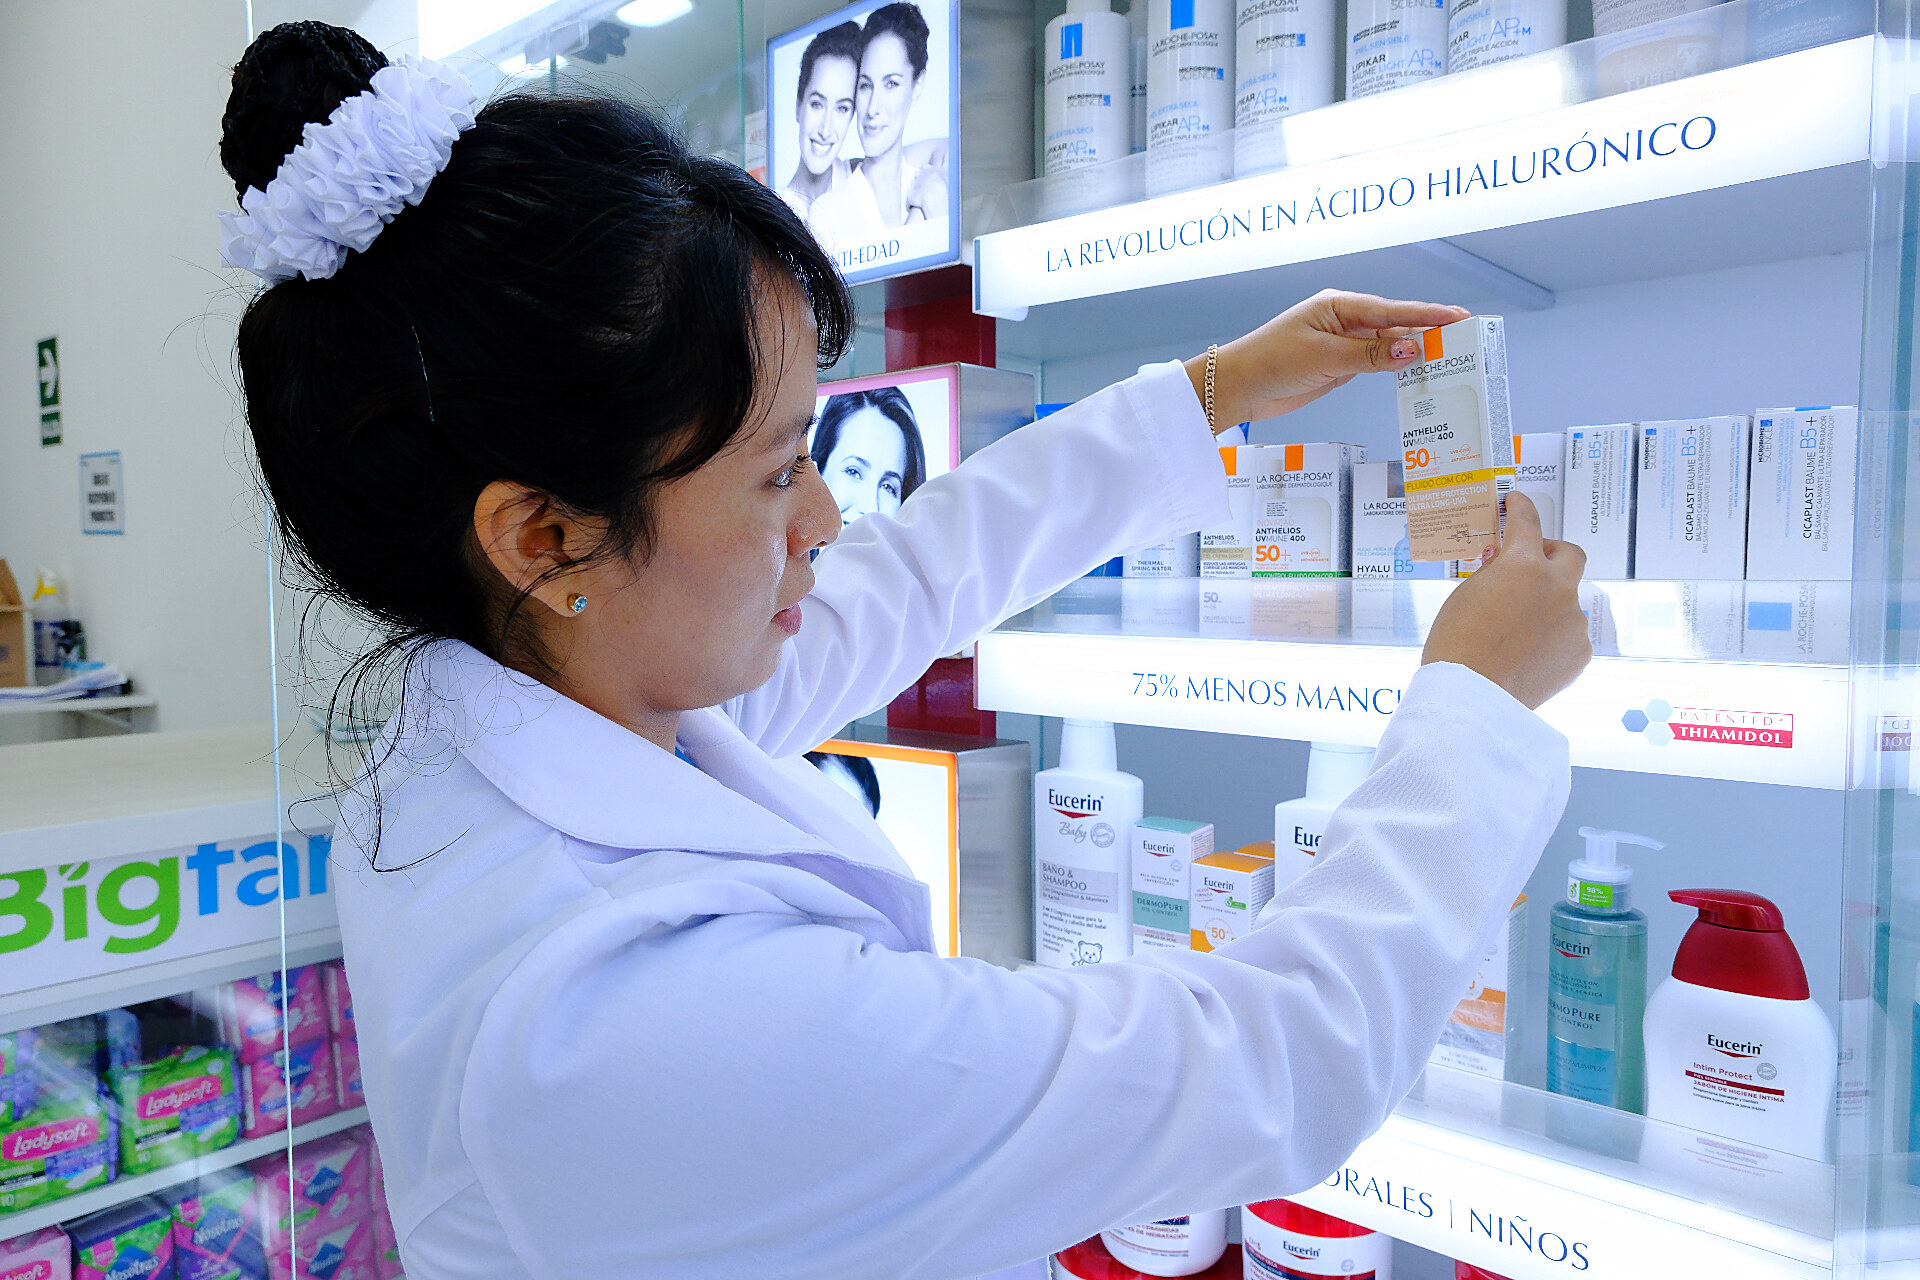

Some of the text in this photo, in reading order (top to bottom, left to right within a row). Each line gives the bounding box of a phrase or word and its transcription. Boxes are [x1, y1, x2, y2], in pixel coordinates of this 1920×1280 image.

[1046, 116, 1717, 273] LA REVOLUCIÓN EN ÁCIDO HIALURÓNICO
[842, 239, 900, 267] TI-EDAD
[1397, 352, 1476, 381] LA ROCHE-POSAY
[1402, 423, 1449, 440] ANTHELIOS
[1403, 431, 1454, 448] UVMUNE 400
[1648, 435, 1657, 470] SCIENCE
[1764, 426, 1773, 462] SCIENCE
[1256, 472, 1334, 484] LA ROCHE-POSAY
[1592, 460, 1601, 489] BAUME
[1687, 459, 1696, 490] BAUME
[1806, 452, 1816, 484] BAUME
[1406, 472, 1474, 492] FLUIDO COM COR
[1408, 484, 1488, 504] ULTIMATE PROTECTION
[1408, 496, 1468, 512] ULTRA LONG-UVA
[1364, 502, 1375, 510] LA
[1590, 490, 1600, 534] CICAPLAST
[1685, 492, 1694, 541] CICAPLAST
[1802, 486, 1814, 538] CICAPLAST
[1256, 527, 1302, 535] ANTHELIOS
[1356, 560, 1414, 573] HYALU B5
[1132, 672, 1178, 698] 75%
[1186, 676, 1288, 708] MENOS
[1678, 726, 1784, 745] THIAMIDOL
[1048, 788, 1102, 812] Eucerin
[1058, 821, 1088, 844] Baby
[1142, 840, 1175, 854] Eucerin
[1042, 863, 1074, 878] BAÑO &
[1042, 874, 1087, 892] SHAMPOO
[1204, 876, 1234, 891] Eucerin
[1552, 933, 1590, 956] Eucerin
[1708, 1034, 1762, 1055] Eucerin
[1694, 1062, 1753, 1081] Intim Protect
[145, 1080, 212, 1116] Ladysoft
[1694, 1080, 1716, 1090] JABÓN
[1728, 1088, 1758, 1100] HIGIENE
[13, 1122, 90, 1158] Ladysoft
[137, 1150, 152, 1164] 10
[1322, 1168, 1589, 1271] ORALES NIÑOS
[1282, 1240, 1320, 1257] Eucerin
